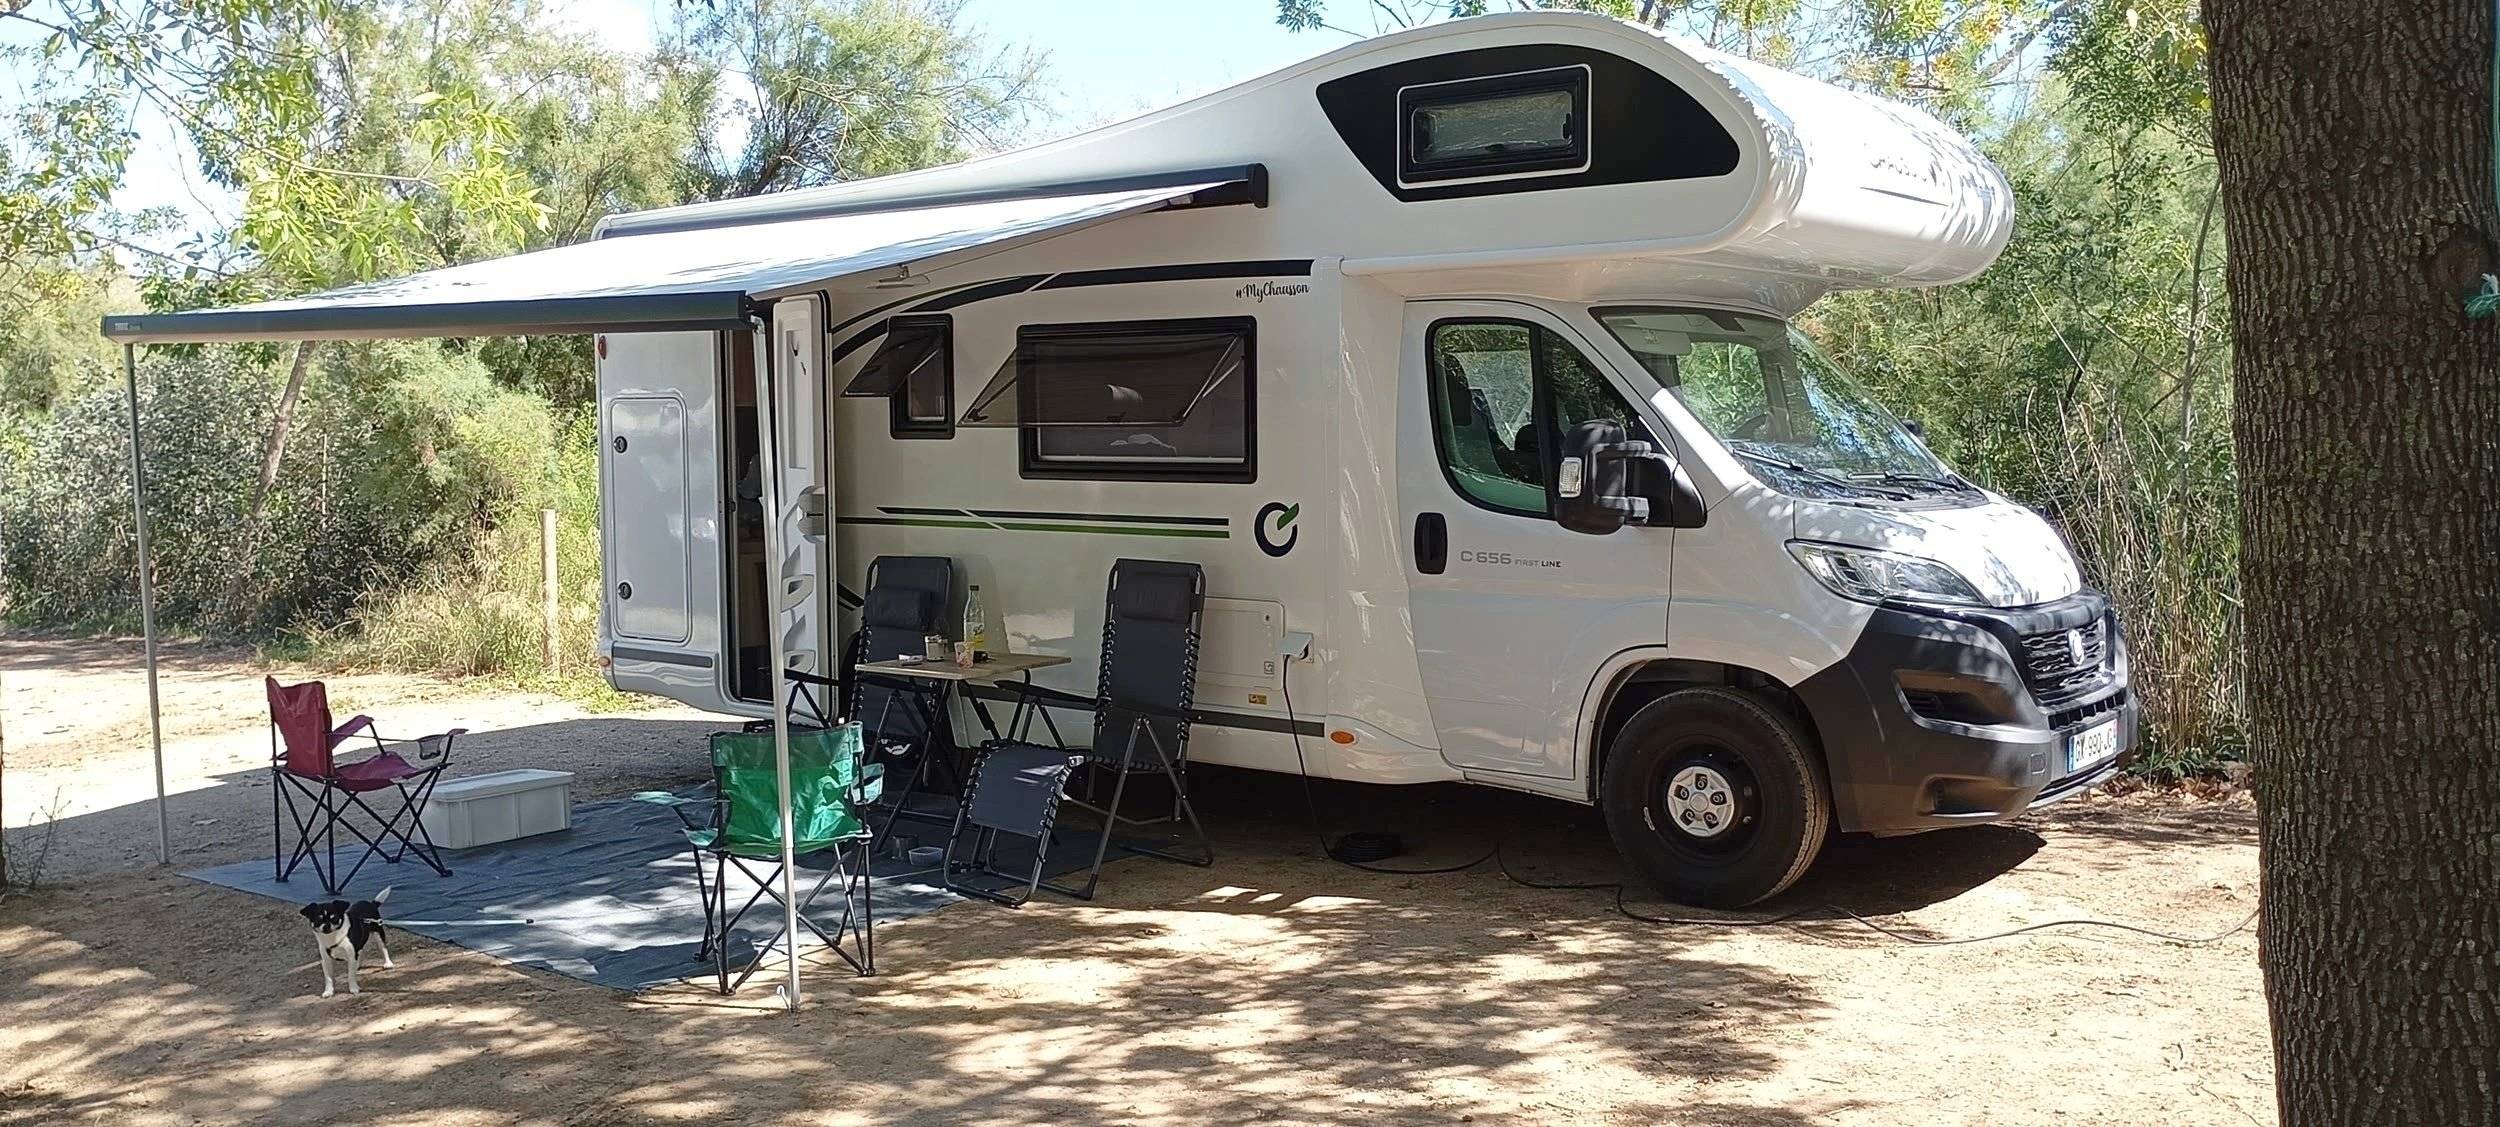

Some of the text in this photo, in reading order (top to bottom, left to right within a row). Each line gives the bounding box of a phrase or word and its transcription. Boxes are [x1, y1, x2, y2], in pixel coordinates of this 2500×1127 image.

[1460, 550, 1473, 562] C
[1476, 551, 1512, 565] 656
[1541, 560, 1562, 568] LINE
